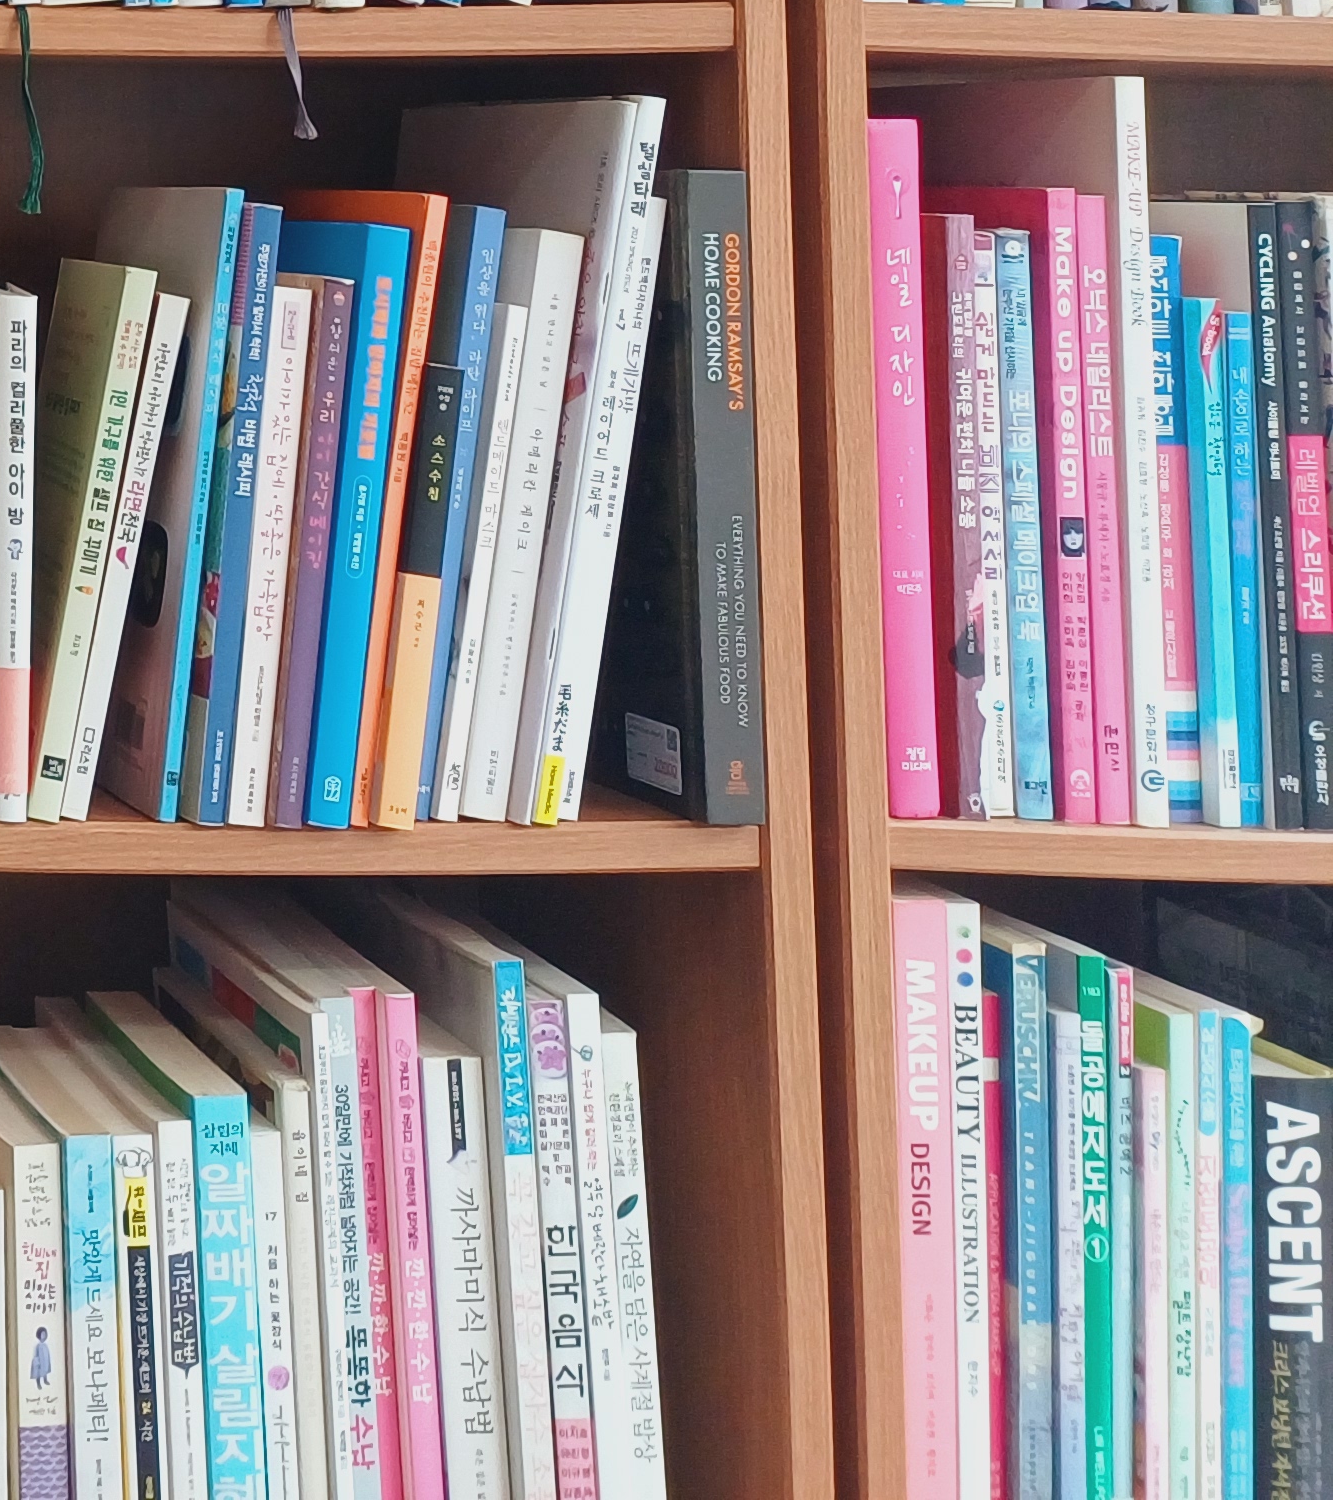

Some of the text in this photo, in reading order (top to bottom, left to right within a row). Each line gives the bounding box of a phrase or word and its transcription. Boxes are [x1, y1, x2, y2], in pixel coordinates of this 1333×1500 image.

[703, 232, 724, 383] HOME COOKING
[723, 233, 746, 412] GORDON RAMSAY'S
[888, 324, 916, 408] 디자인
[1052, 225, 1081, 500] Make up Design
[1082, 265, 1114, 458] 오닉스 네일리스트
[1256, 232, 1279, 386] CYCLING Anatomy
[715, 541, 729, 561] TO
[715, 563, 729, 599] MAKE
[1298, 525, 1326, 620] 스리쿠션
[717, 666, 732, 705] FOOD
[905, 958, 939, 1237] MAKEUP DESIGN
[953, 1002, 981, 1325] BEAUTY ILLUSTRATION
[199, 1163, 255, 1328] 알짜배기
[1265, 1100, 1323, 1344] ASCENT
[448, 1186, 494, 1435] 까사마미식 수납법
[617, 1227, 659, 1463] 자연을 담은 사계절 밥상
